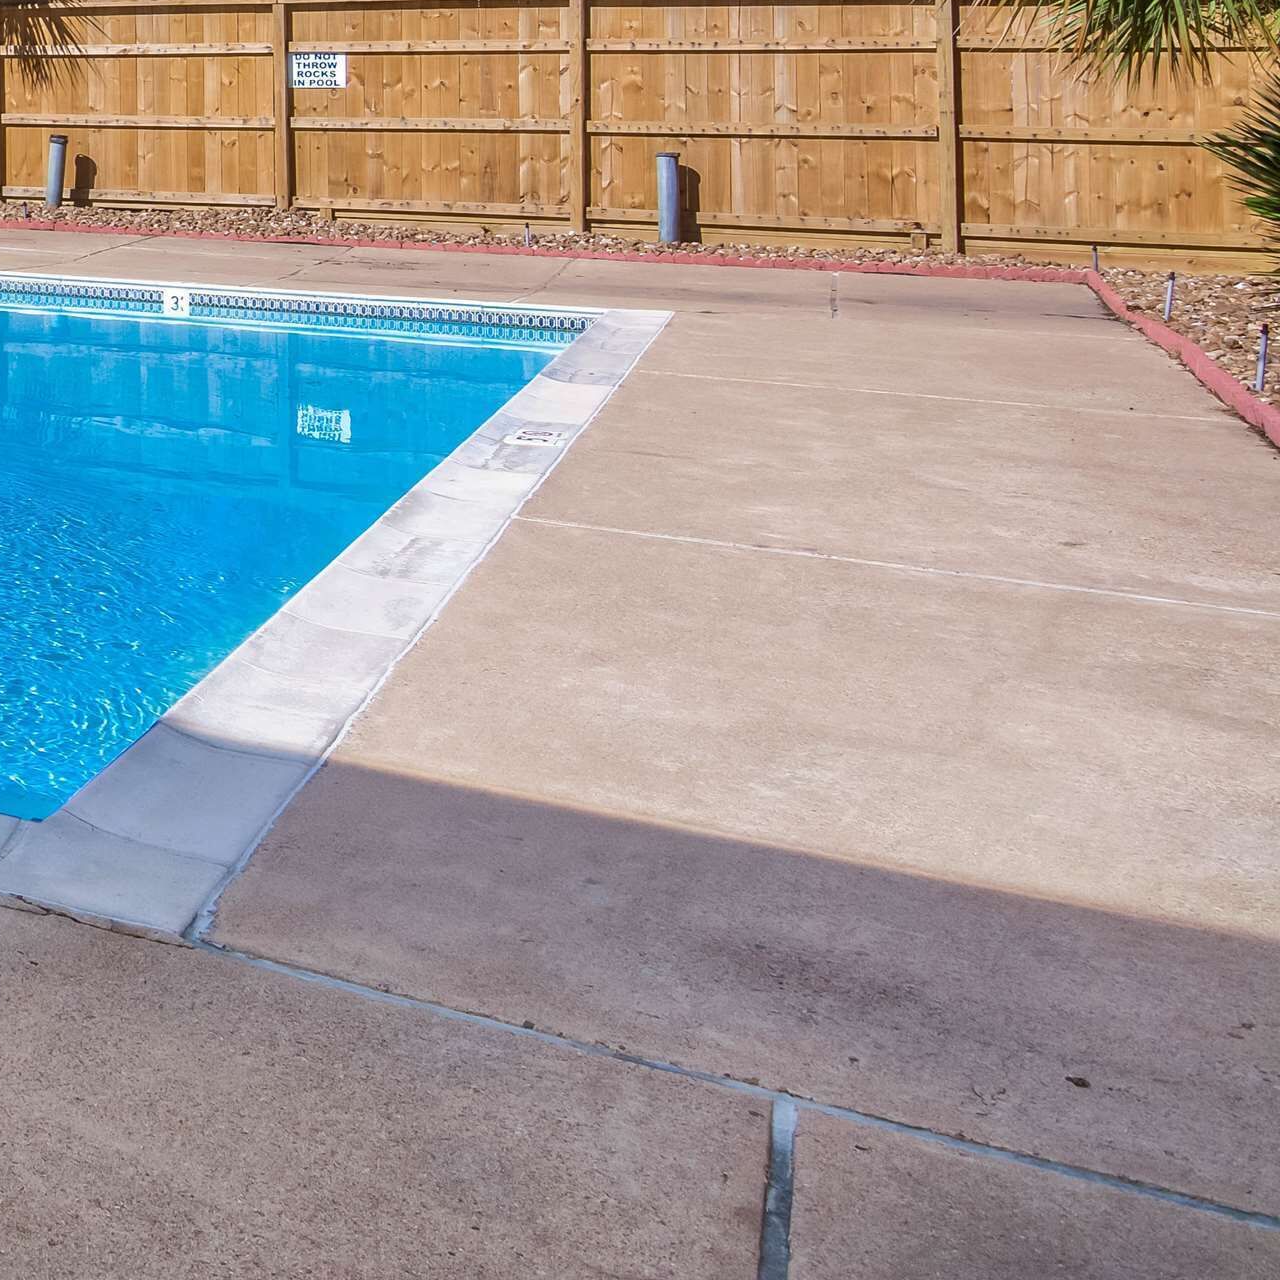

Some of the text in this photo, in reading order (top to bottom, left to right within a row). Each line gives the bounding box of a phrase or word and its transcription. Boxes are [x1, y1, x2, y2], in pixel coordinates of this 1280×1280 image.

[296, 62, 338, 70] THROW
[297, 70, 337, 78] ROCKS
[294, 79, 341, 87] IN POOL
